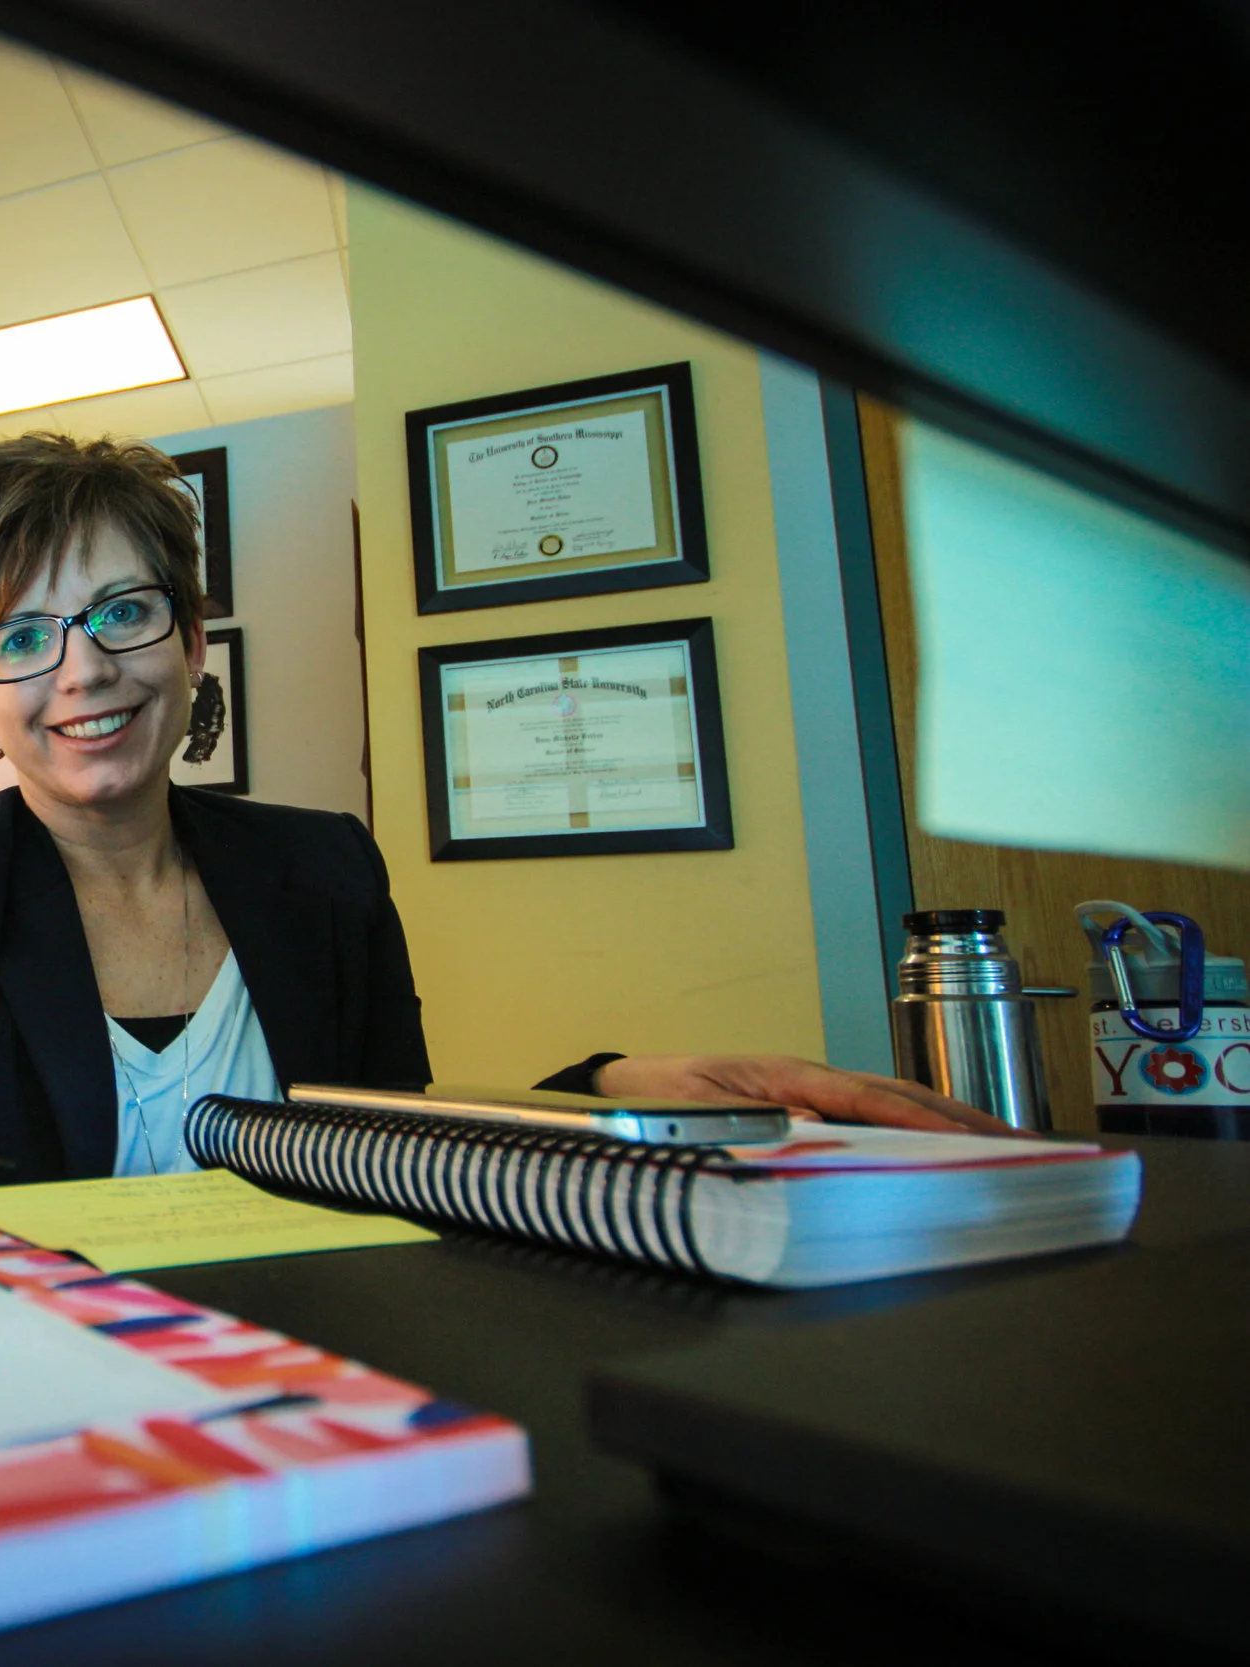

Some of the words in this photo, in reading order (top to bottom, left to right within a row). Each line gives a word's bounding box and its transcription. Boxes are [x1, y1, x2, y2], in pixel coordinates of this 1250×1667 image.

[485, 441, 526, 458] University
[526, 436, 535, 447] of
[536, 432, 574, 444] Southern
[575, 428, 624, 441] Mississippi
[486, 691, 515, 713] North
[516, 682, 559, 699] Carolina
[561, 677, 587, 690] State
[592, 676, 648, 700] University
[1093, 1018, 1117, 1035] st.
